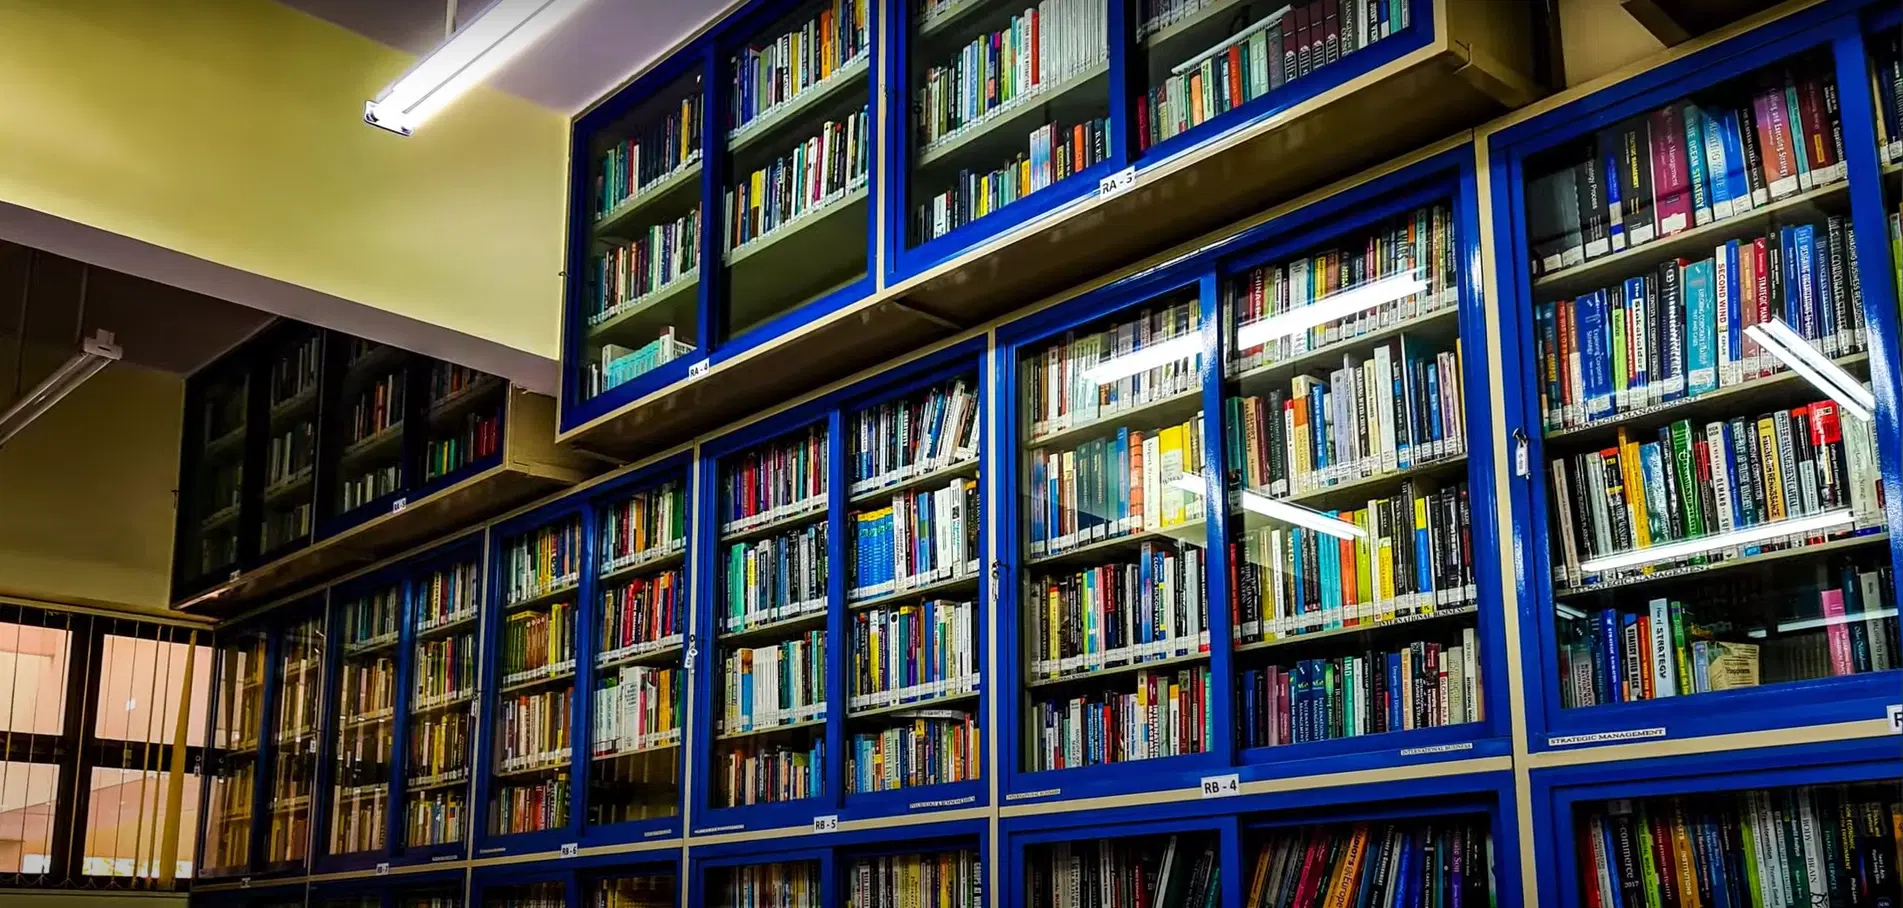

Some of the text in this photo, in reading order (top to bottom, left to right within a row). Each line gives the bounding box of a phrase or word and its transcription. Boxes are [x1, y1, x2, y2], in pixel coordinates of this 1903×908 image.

[1771, 111, 1789, 178] and Executing Strategy
[1667, 145, 1682, 186] Management
[1685, 117, 1707, 209] BLUE OCEAN STRATEGY
[1102, 176, 1116, 194] RA
[1589, 184, 1600, 209] Process
[1799, 245, 1810, 273] DESIGNING
[1848, 230, 1860, 290] MANAGING BUSINESS
[1716, 263, 1729, 323] SECOND WIND
[1758, 276, 1769, 305] STRATEGIC
[1831, 254, 1845, 301] CORPORATE
[1613, 314, 1622, 337] Valuation
[1632, 300, 1646, 370] Stakeholder
[1585, 331, 1594, 355] Strategy
[1590, 329, 1604, 385] Exploring Corporate
[690, 367, 699, 376] RA
[1716, 478, 1726, 506] DEMAND
[1751, 464, 1762, 500] COMPETITION
[1762, 436, 1780, 517] STRATEGIC RENAISSANCE
[1786, 483, 1798, 508] CAPITAL
[1627, 628, 1640, 689] STRATEGY BACK
[1655, 627, 1667, 679] STRATEGY
[1402, 746, 1443, 755] INTERNATIONAL
[1551, 729, 1664, 744] STRATEGIC MANAGEMENT
[1204, 782, 1220, 794] RB
[1229, 780, 1238, 792] 4
[816, 821, 825, 830] RB
[831, 819, 836, 828] 5
[1761, 812, 1773, 860] Transformation
[1453, 857, 1461, 873] Son
[1802, 819, 1817, 884] BODY BRAIN
[972, 862, 982, 885] GROUPS
[1336, 870, 1351, 908] Europe
[1624, 880, 1640, 888] 2017
[1680, 850, 1692, 896] INSTITUTIONS
